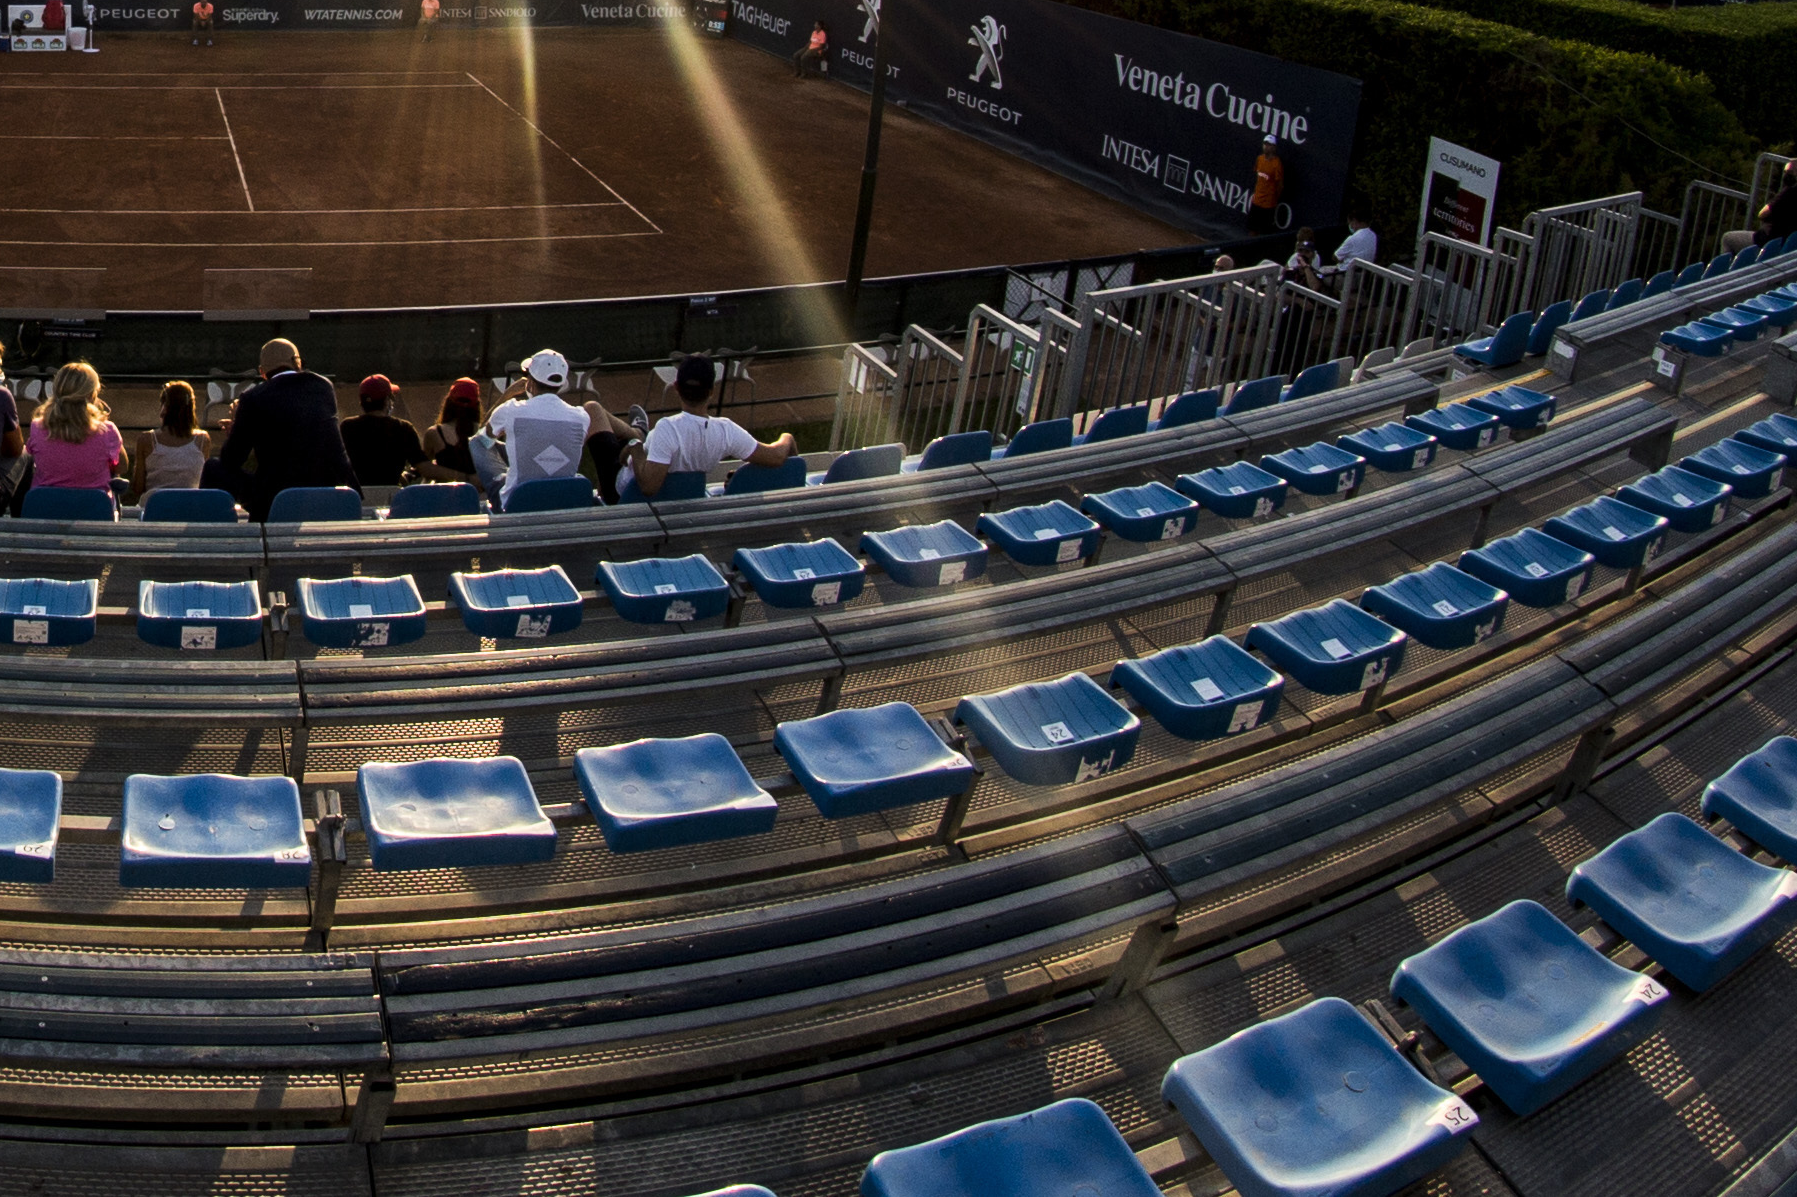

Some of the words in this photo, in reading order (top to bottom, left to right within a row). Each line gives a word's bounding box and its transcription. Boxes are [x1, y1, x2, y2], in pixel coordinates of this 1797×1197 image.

[99, 8, 181, 20] PEUGEOT
[304, 8, 403, 21] WTATENNIS.COM
[581, 3, 633, 19] Veneta
[635, 1, 686, 19] Cucine
[731, 0, 792, 37] TAGHeuer
[841, 48, 901, 79] PEUGT
[947, 86, 1023, 126] PEUGEOT
[1114, 53, 1201, 111] Veneta
[1205, 82, 1309, 145] Cucine
[1440, 152, 1486, 178] CUSUMANO
[1101, 134, 1161, 179] INTESA
[1191, 169, 1293, 230] SANPAO
[1050, 728, 1067, 740] 24
[1640, 982, 1661, 999] 24
[1444, 1106, 1469, 1126] 25
